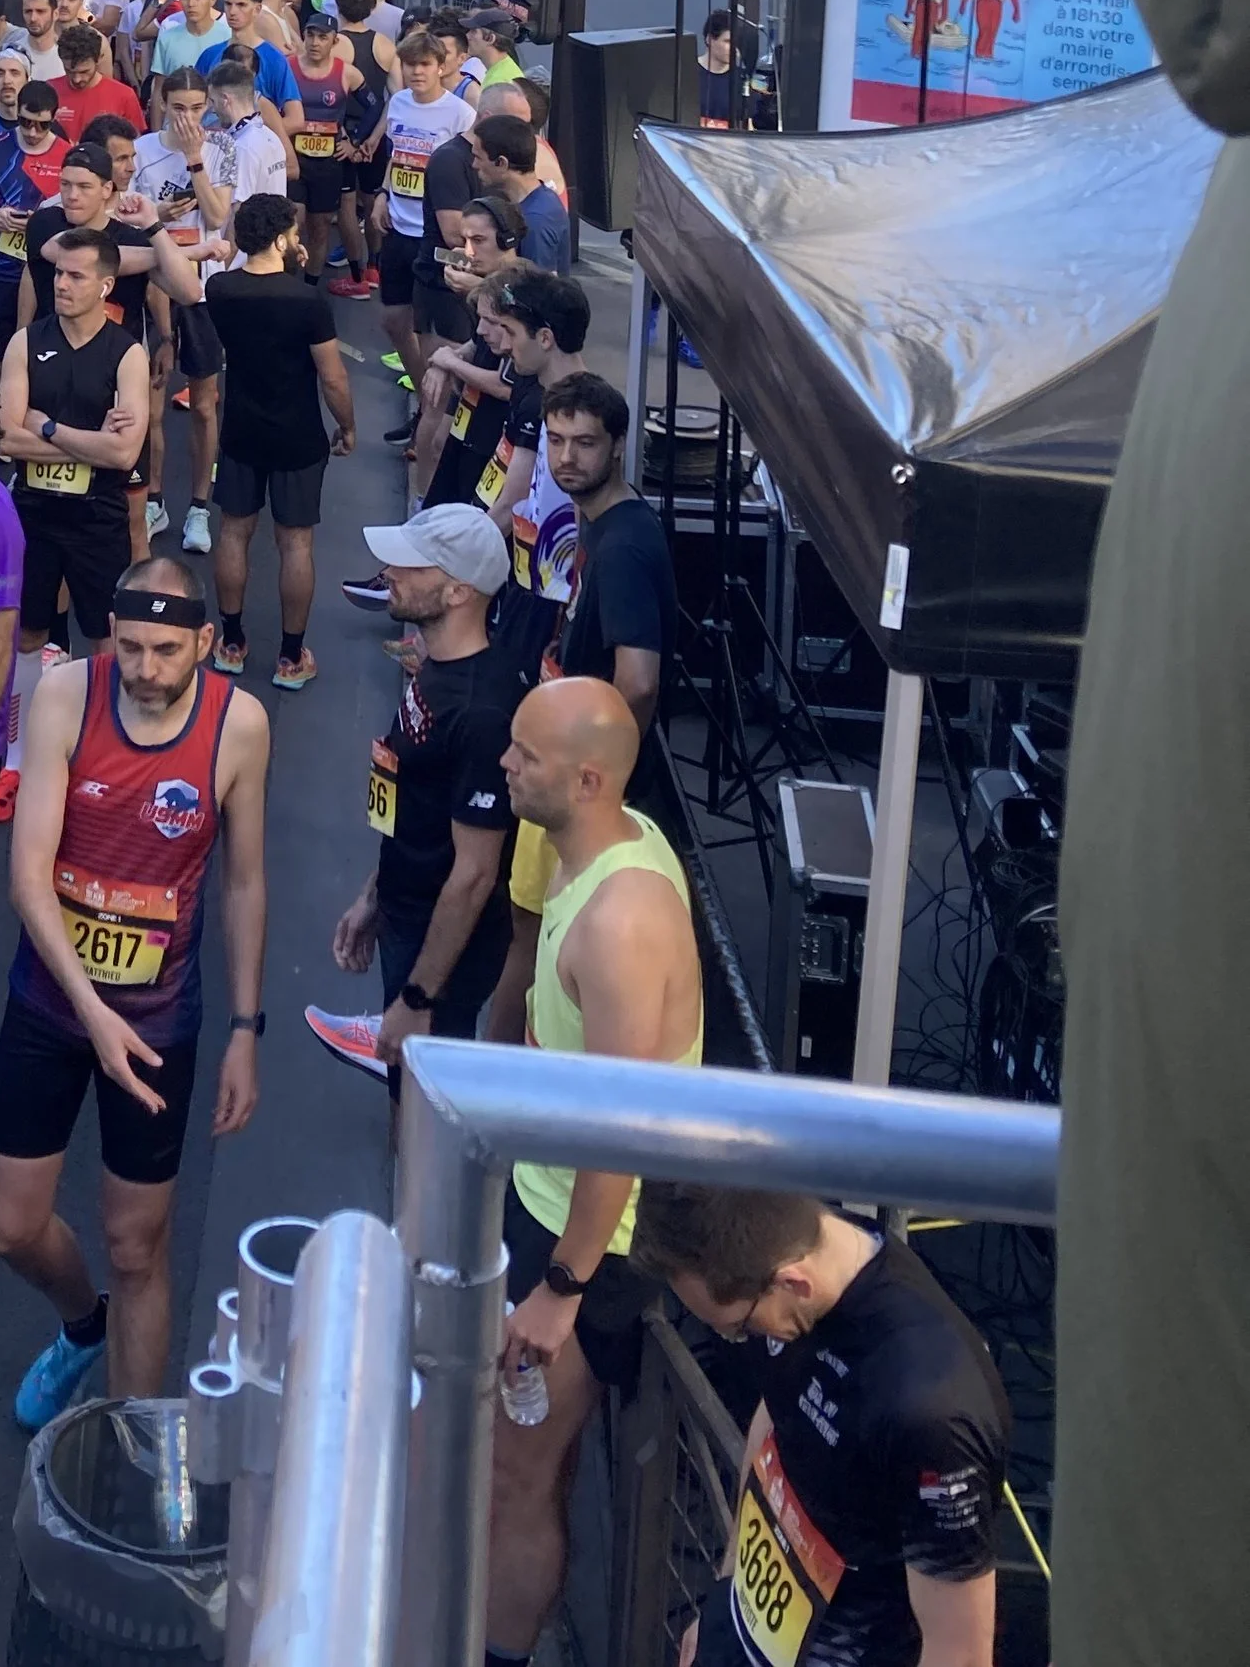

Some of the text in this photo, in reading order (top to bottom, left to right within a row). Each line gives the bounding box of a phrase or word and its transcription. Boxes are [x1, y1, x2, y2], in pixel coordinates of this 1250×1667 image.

[1057, 5, 1123, 26] à 18h30
[1043, 21, 1135, 45] dans votre
[1061, 42, 1114, 60] mairie
[302, 137, 328, 151] 3082
[396, 170, 419, 189] 6017
[74, 922, 142, 969] 2617
[739, 1518, 792, 1633] 3688
